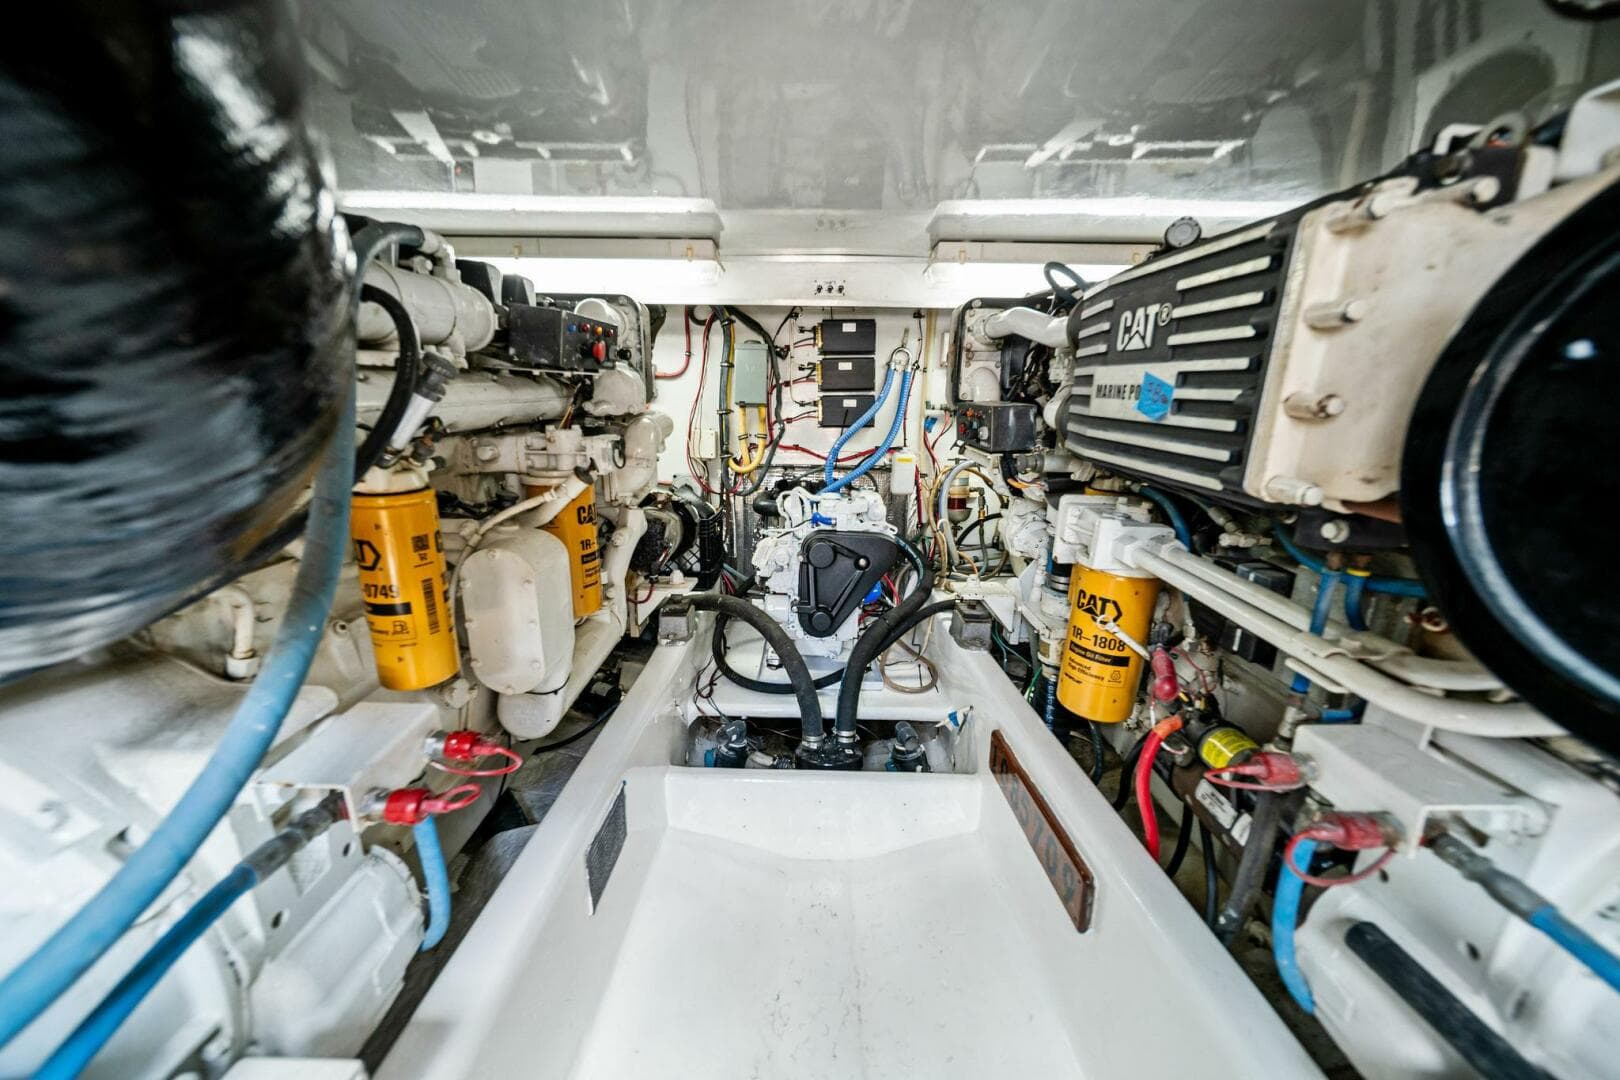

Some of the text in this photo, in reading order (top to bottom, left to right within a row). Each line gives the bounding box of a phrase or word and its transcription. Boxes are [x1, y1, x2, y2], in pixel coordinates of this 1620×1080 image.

[1095, 384, 1127, 400] MARINE
[1077, 588, 1112, 617] CAT
[1072, 624, 1127, 653] 1R-1808
